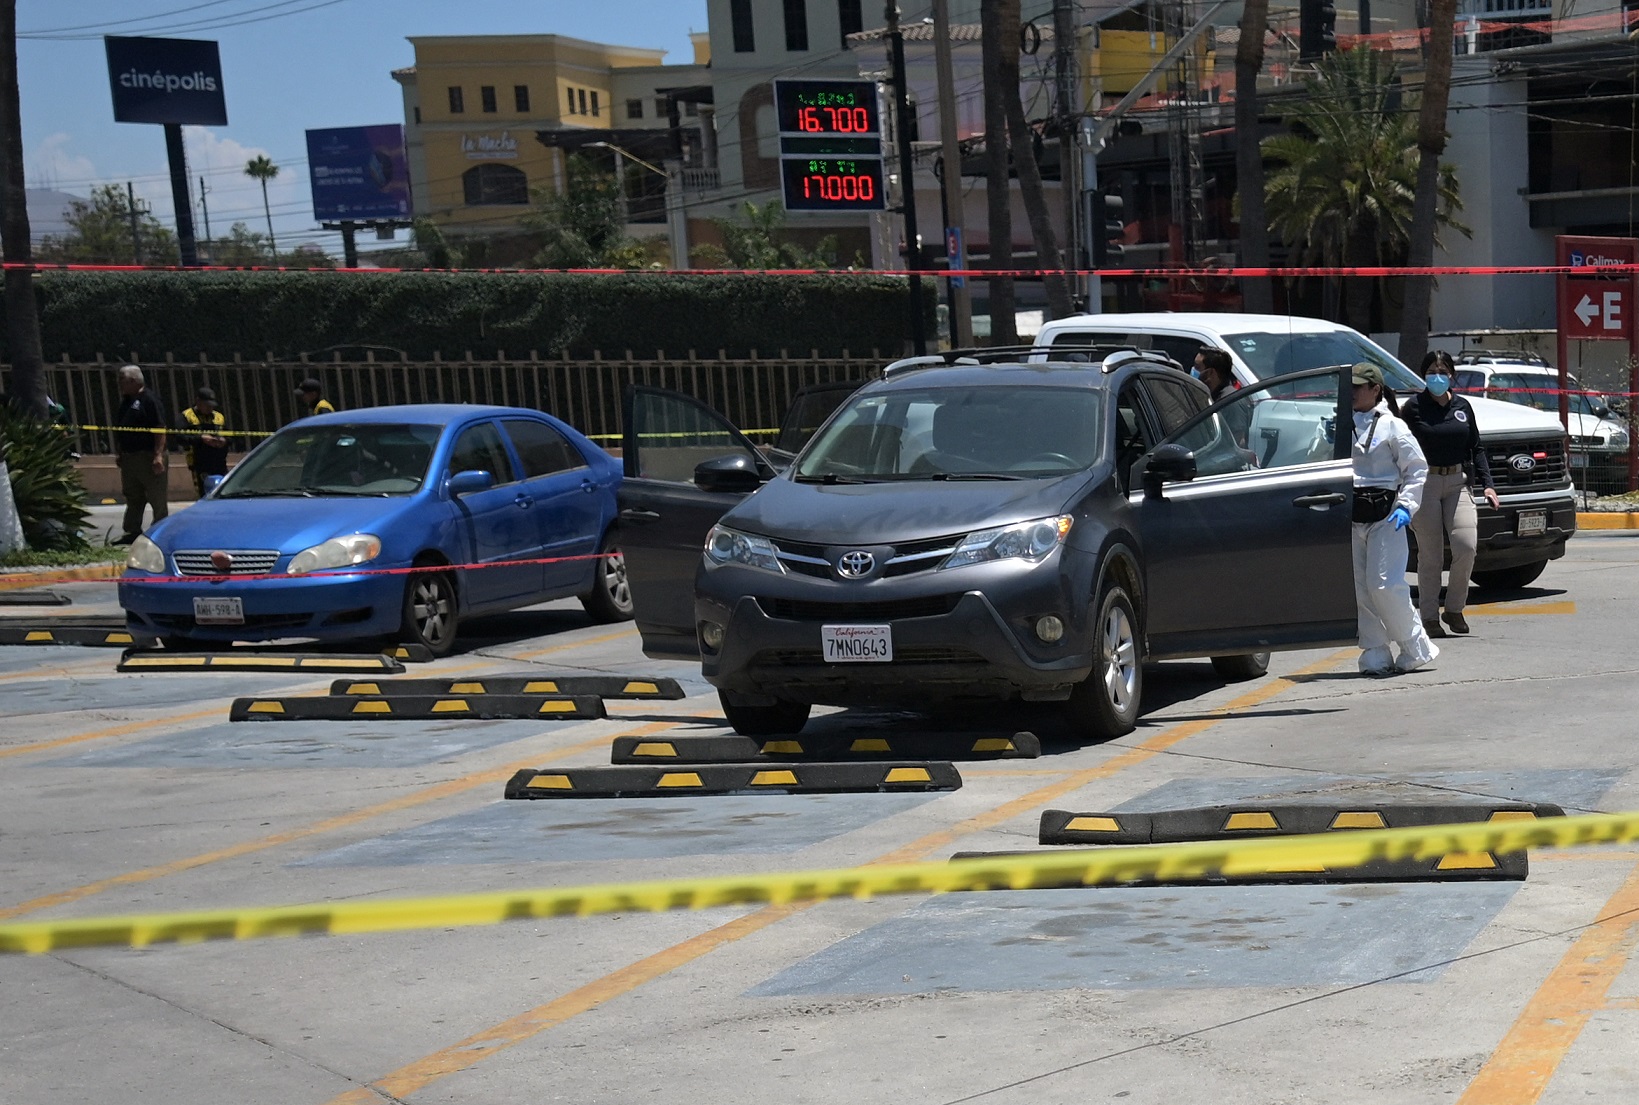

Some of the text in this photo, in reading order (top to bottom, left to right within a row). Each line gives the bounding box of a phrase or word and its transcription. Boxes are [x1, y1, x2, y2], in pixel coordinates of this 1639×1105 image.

[120, 67, 218, 93] cinépolis
[798, 107, 868, 132] 16.700
[804, 175, 873, 200] 17.000
[1585, 255, 1626, 267] Calimax
[1603, 291, 1622, 330] E
[835, 627, 877, 638] California
